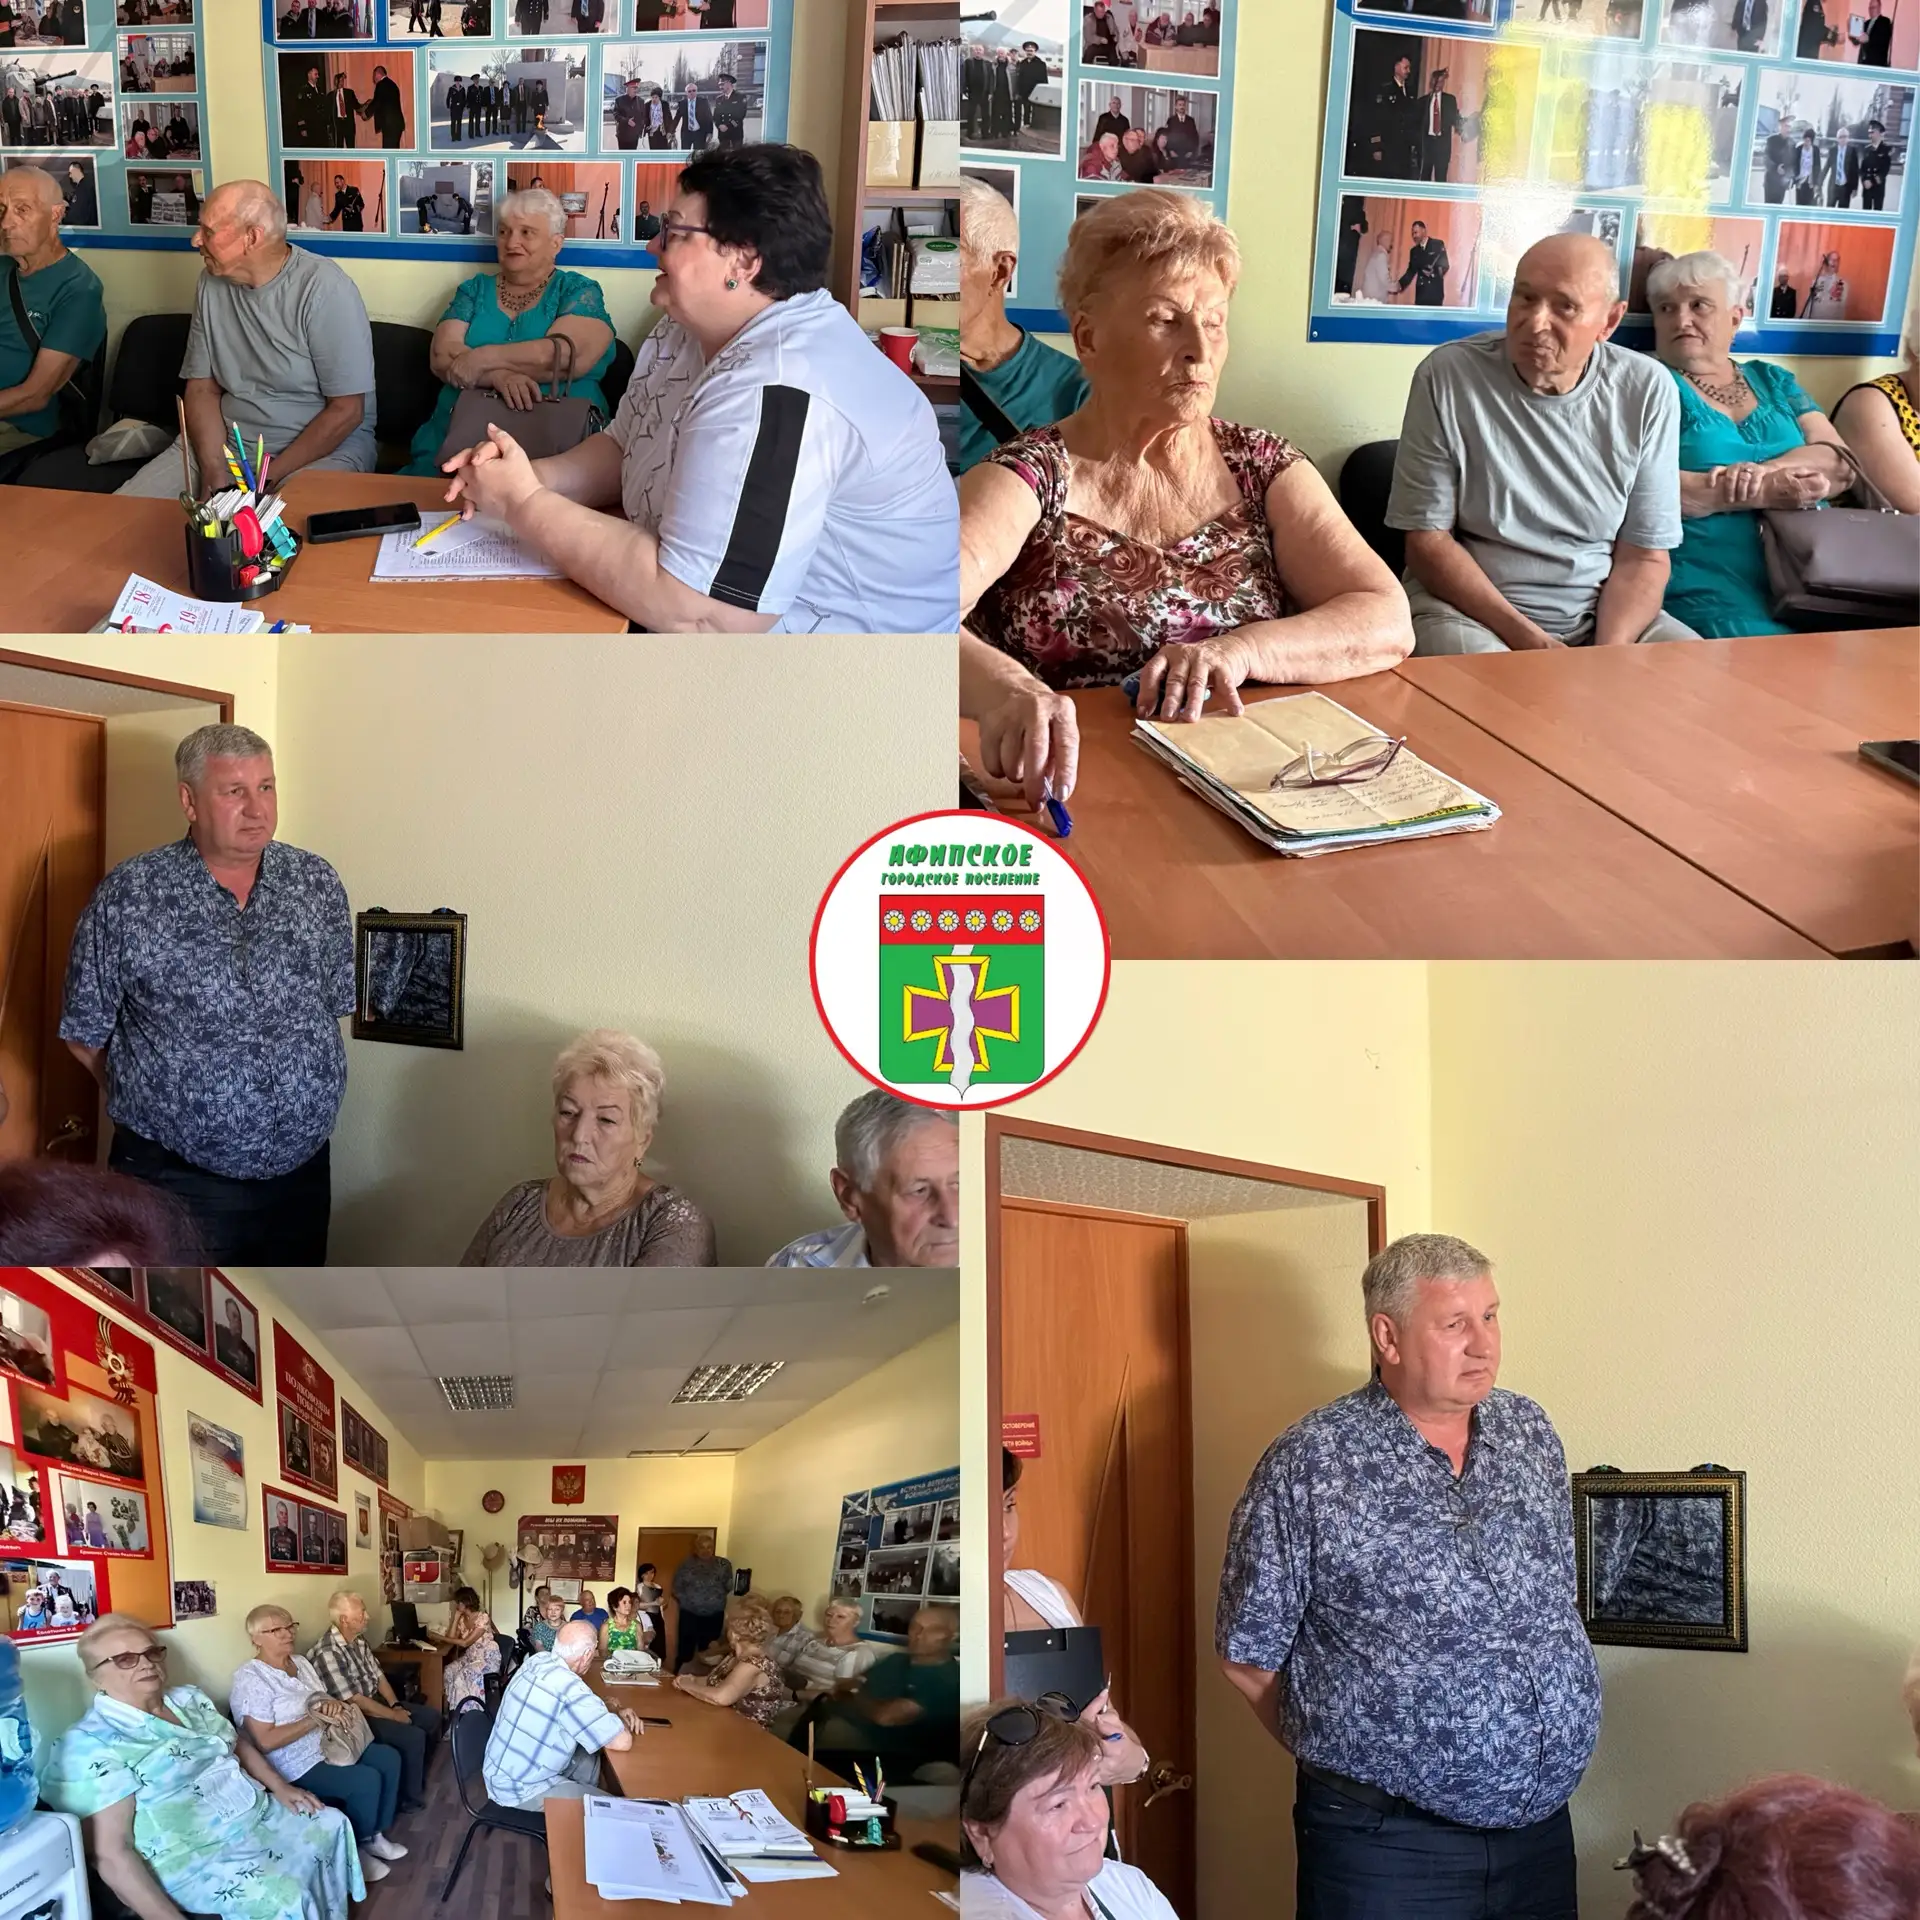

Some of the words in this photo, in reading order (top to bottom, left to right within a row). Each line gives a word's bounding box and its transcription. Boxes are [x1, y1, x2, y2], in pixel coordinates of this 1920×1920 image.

[132, 590, 152, 606] 18
[178, 609, 198, 625] 19
[708, 1803, 721, 1811] 17
[763, 1815, 777, 1825] 19
